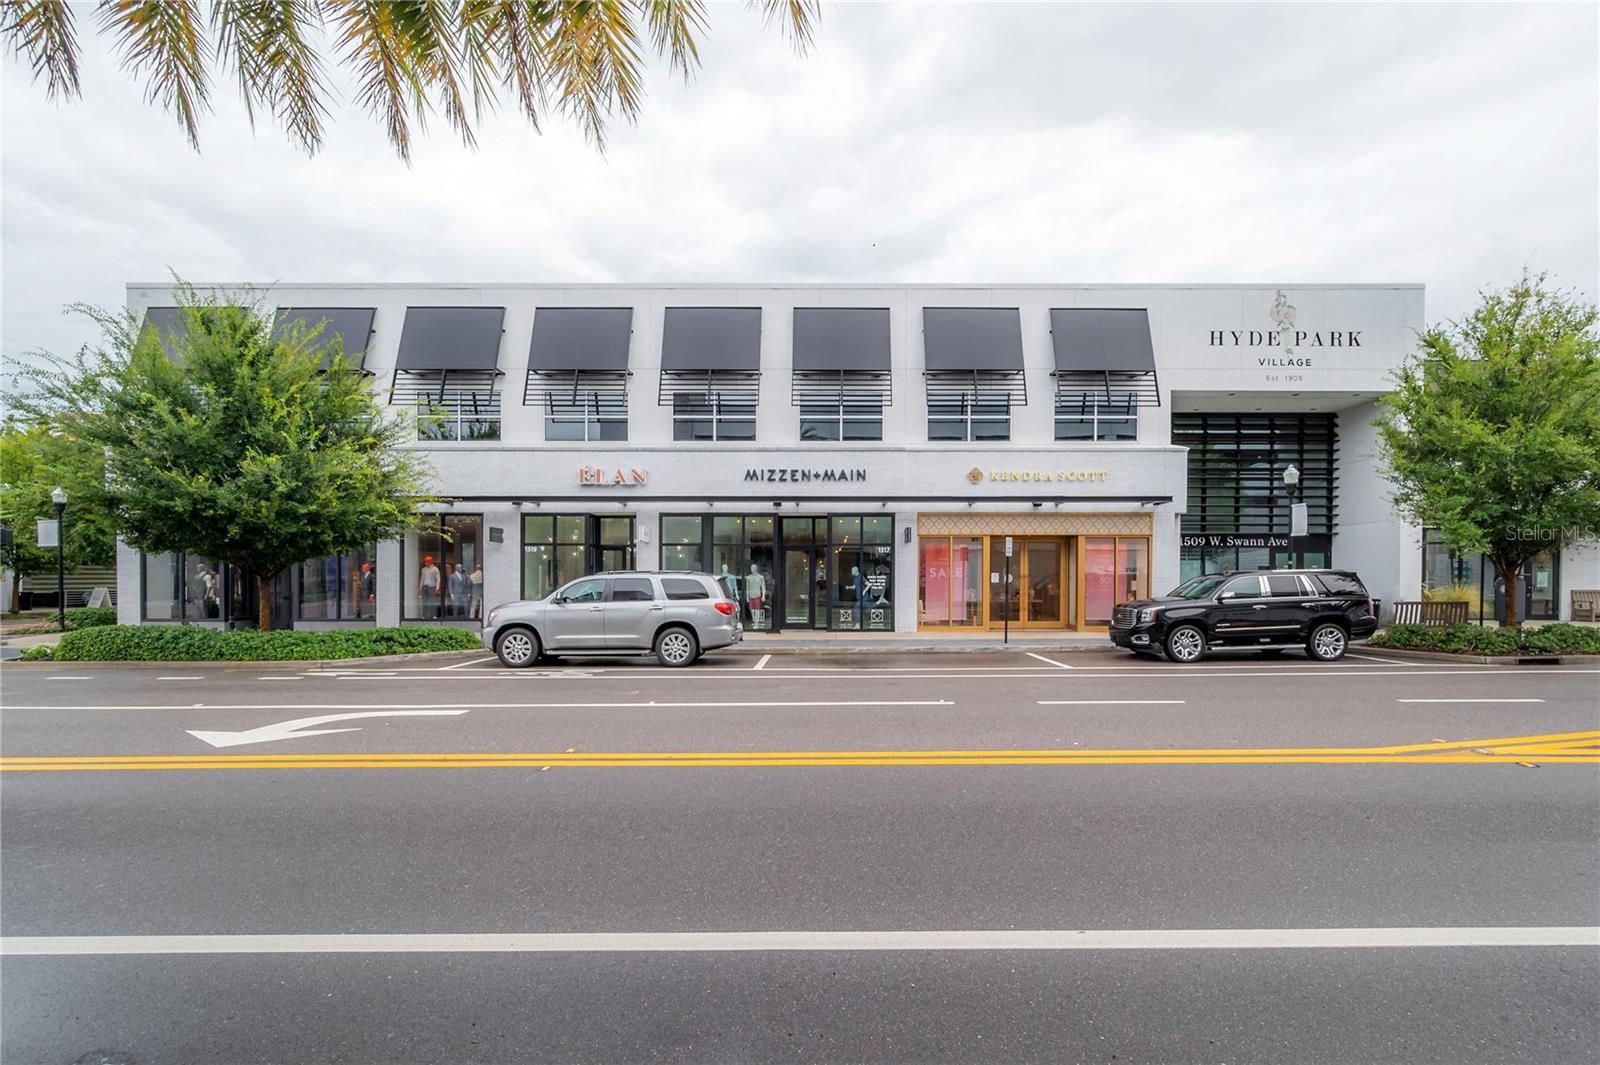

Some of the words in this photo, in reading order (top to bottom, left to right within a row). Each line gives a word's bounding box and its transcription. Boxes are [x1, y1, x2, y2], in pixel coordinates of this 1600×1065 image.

[1209, 330, 1281, 347] HYDE
[1295, 330, 1363, 347] PARK
[1258, 358, 1312, 367] VILLAGE
[1285, 374, 1304, 382] 1905
[990, 471, 1053, 482] KENDRA
[1057, 471, 1109, 482] SCOTT
[1209, 536, 1224, 547] W.
[1226, 536, 1265, 547] Swann
[1267, 536, 1288, 547] Ave
[929, 567, 963, 578] SAE
